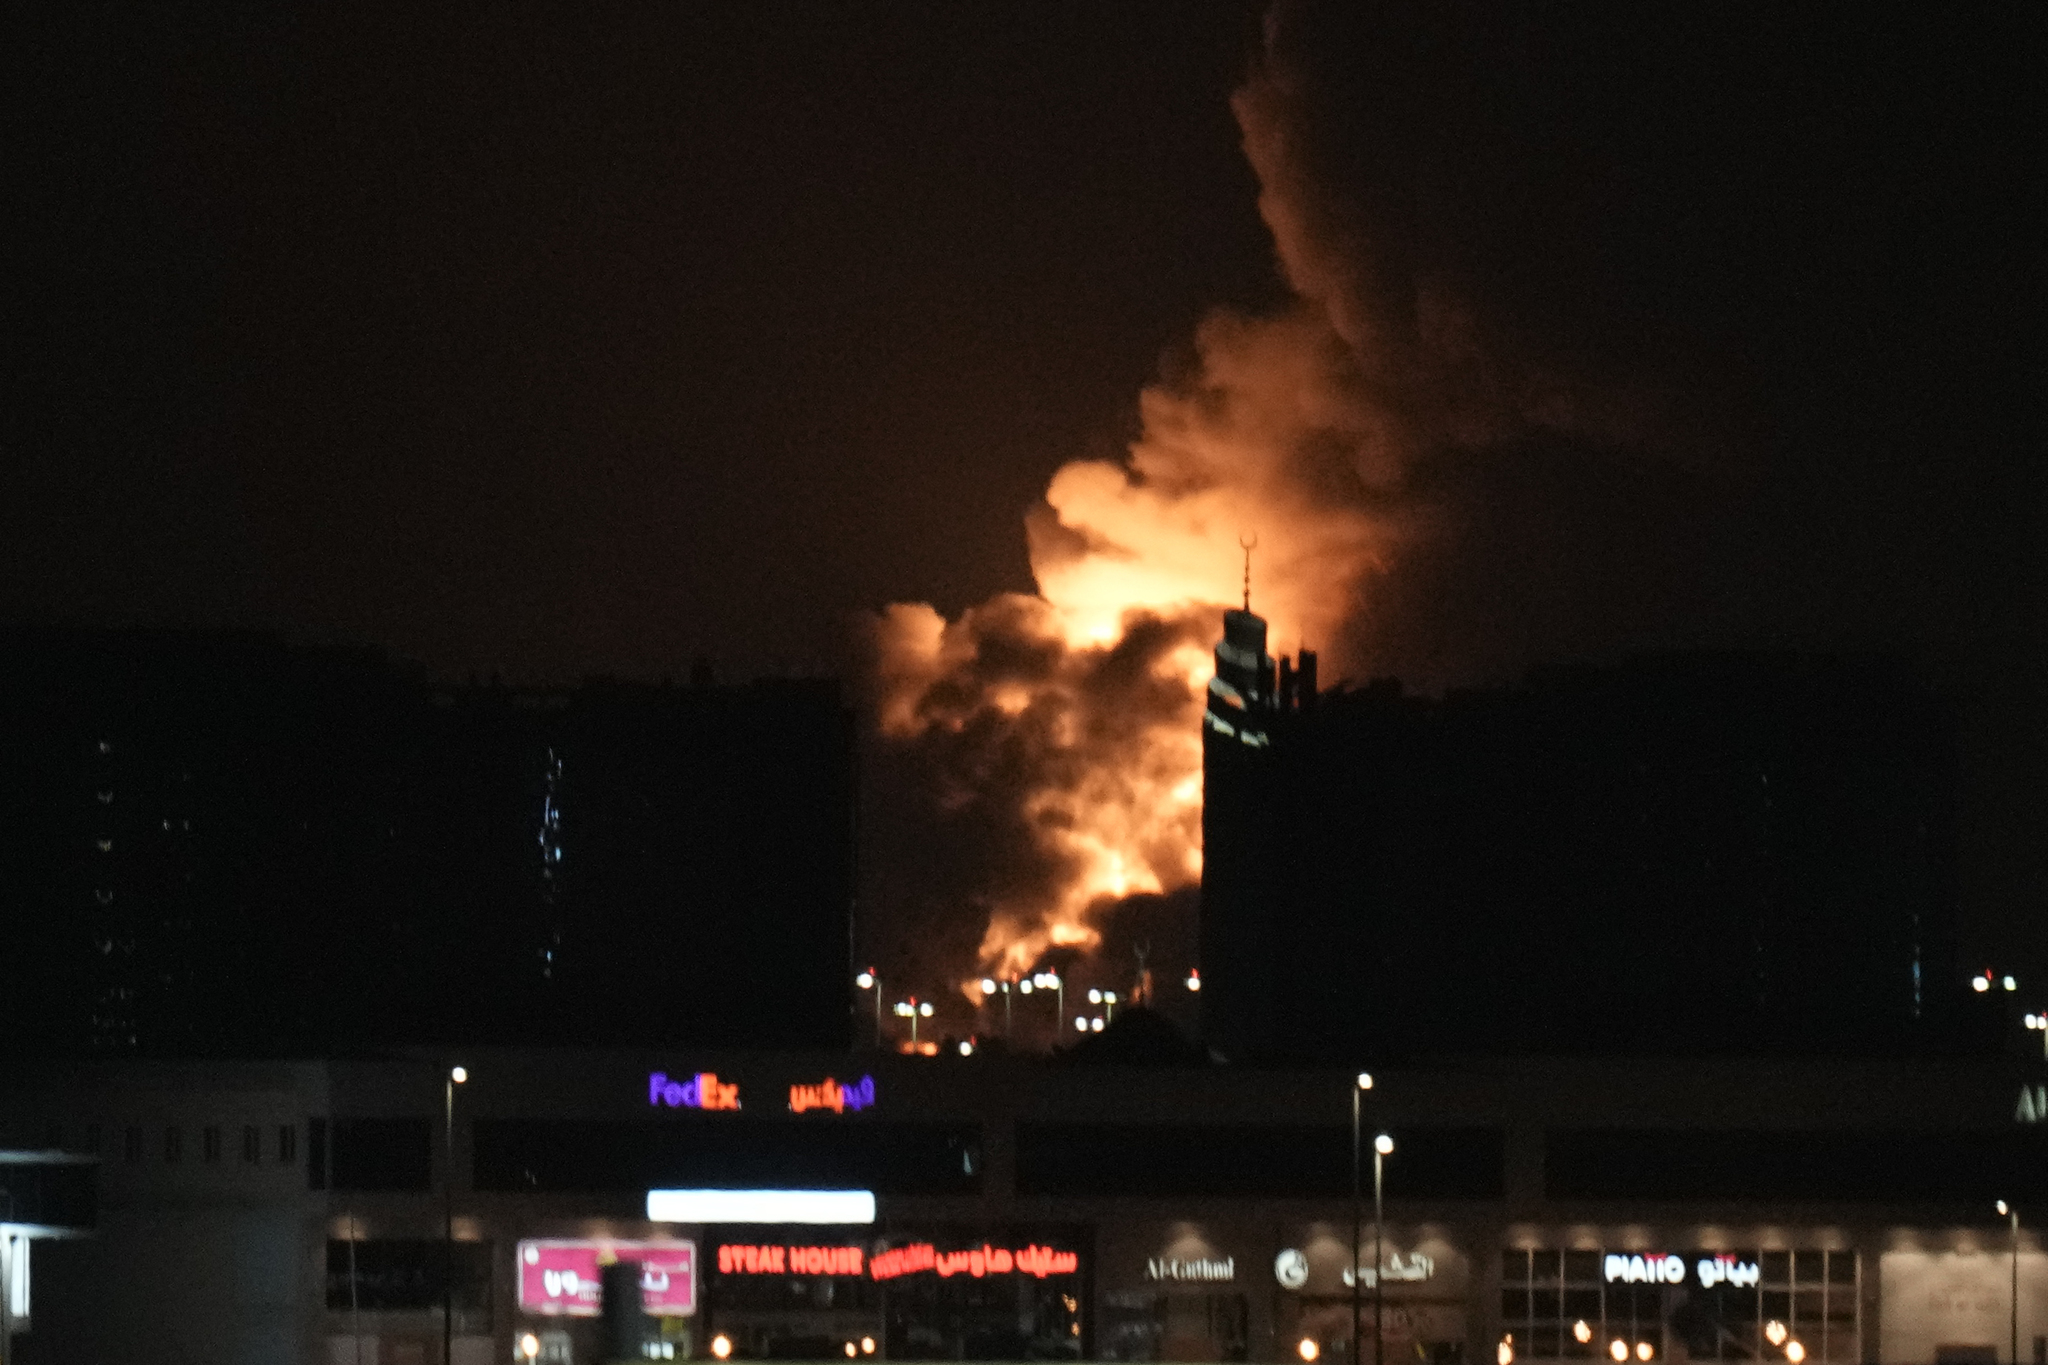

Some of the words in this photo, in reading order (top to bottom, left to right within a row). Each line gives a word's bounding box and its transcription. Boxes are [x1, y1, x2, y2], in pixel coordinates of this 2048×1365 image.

[649, 1072, 739, 1110] FedEx
[718, 1244, 785, 1274] STEAK
[790, 1246, 863, 1275] HOUSE
